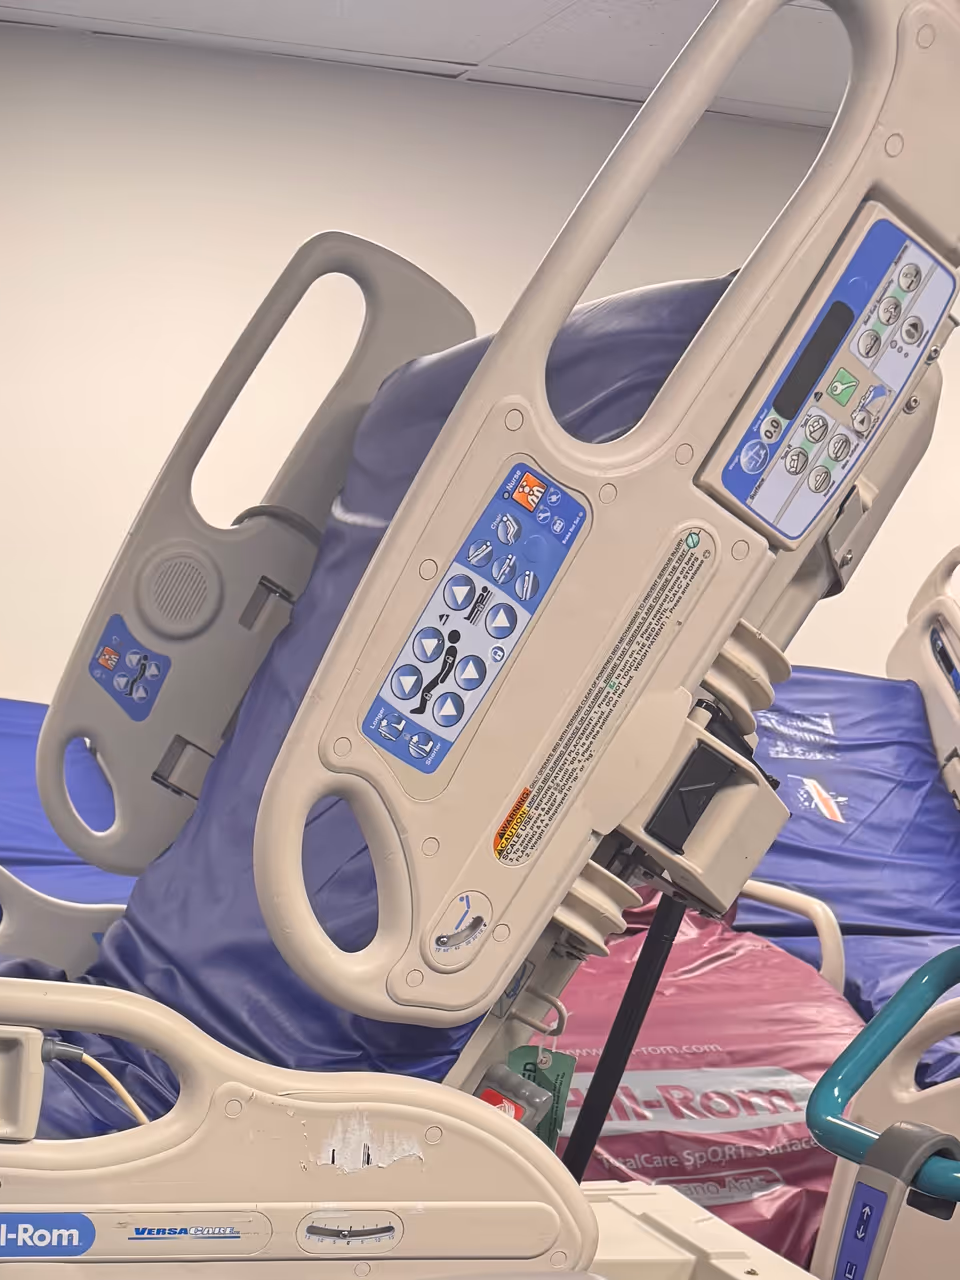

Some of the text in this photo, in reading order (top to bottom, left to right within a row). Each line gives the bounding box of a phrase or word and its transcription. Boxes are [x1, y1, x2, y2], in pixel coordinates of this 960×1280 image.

[762, 417, 782, 441] 0.0
[504, 467, 522, 492] Nurse
[489, 511, 503, 530] Chair
[369, 705, 386, 730] Longer
[499, 787, 532, 834] WARNING:
[579, 687, 593, 705] CLEAR
[594, 654, 613, 681] POWERED
[610, 643, 620, 656] BED
[616, 610, 640, 644] MECHANISMS
[641, 579, 659, 603] PREVENT
[499, 807, 528, 849] CAUTION:
[540, 771, 550, 784] BED
[561, 724, 579, 750] SERVICE
[615, 646, 627, 662] THAT
[643, 602, 654, 616] ARE
[651, 576, 670, 603] OUTSIDE
[667, 565, 676, 577] THE
[502, 832, 522, 861] SCALE
[520, 810, 536, 832] USE:
[532, 783, 552, 811] BEFORE
[549, 755, 570, 784] PATIENT
[566, 714, 595, 757] PLACEMENT:
[596, 689, 610, 708] Press
[639, 620, 653, 638] Place
[650, 593, 670, 621] required
[684, 550, 696, 566] bed.
[515, 829, 538, 862] FLASHING
[580, 739, 593, 757] Place
[590, 728, 600, 740] the
[597, 707, 613, 729] patient
[616, 687, 625, 699] the
[622, 673, 634, 688] bed.
[632, 649, 649, 672] WEIGH
[668, 594, 682, 614] Press
[680, 581, 690, 595] and
[687, 558, 705, 582] release
[528, 811, 542, 830] press
[543, 790, 555, 806] hold
[557, 767, 569, 782] until
[611, 680, 623, 695] NOT
[620, 656, 638, 681] TOUCH
[635, 641, 647, 656] THE
[644, 626, 656, 642] BED
[653, 605, 669, 626] UNTIL
[682, 556, 699, 580] STOPS
[424, 741, 442, 766] Shorter
[529, 828, 545, 850] Weight
[546, 791, 568, 822] displayed
